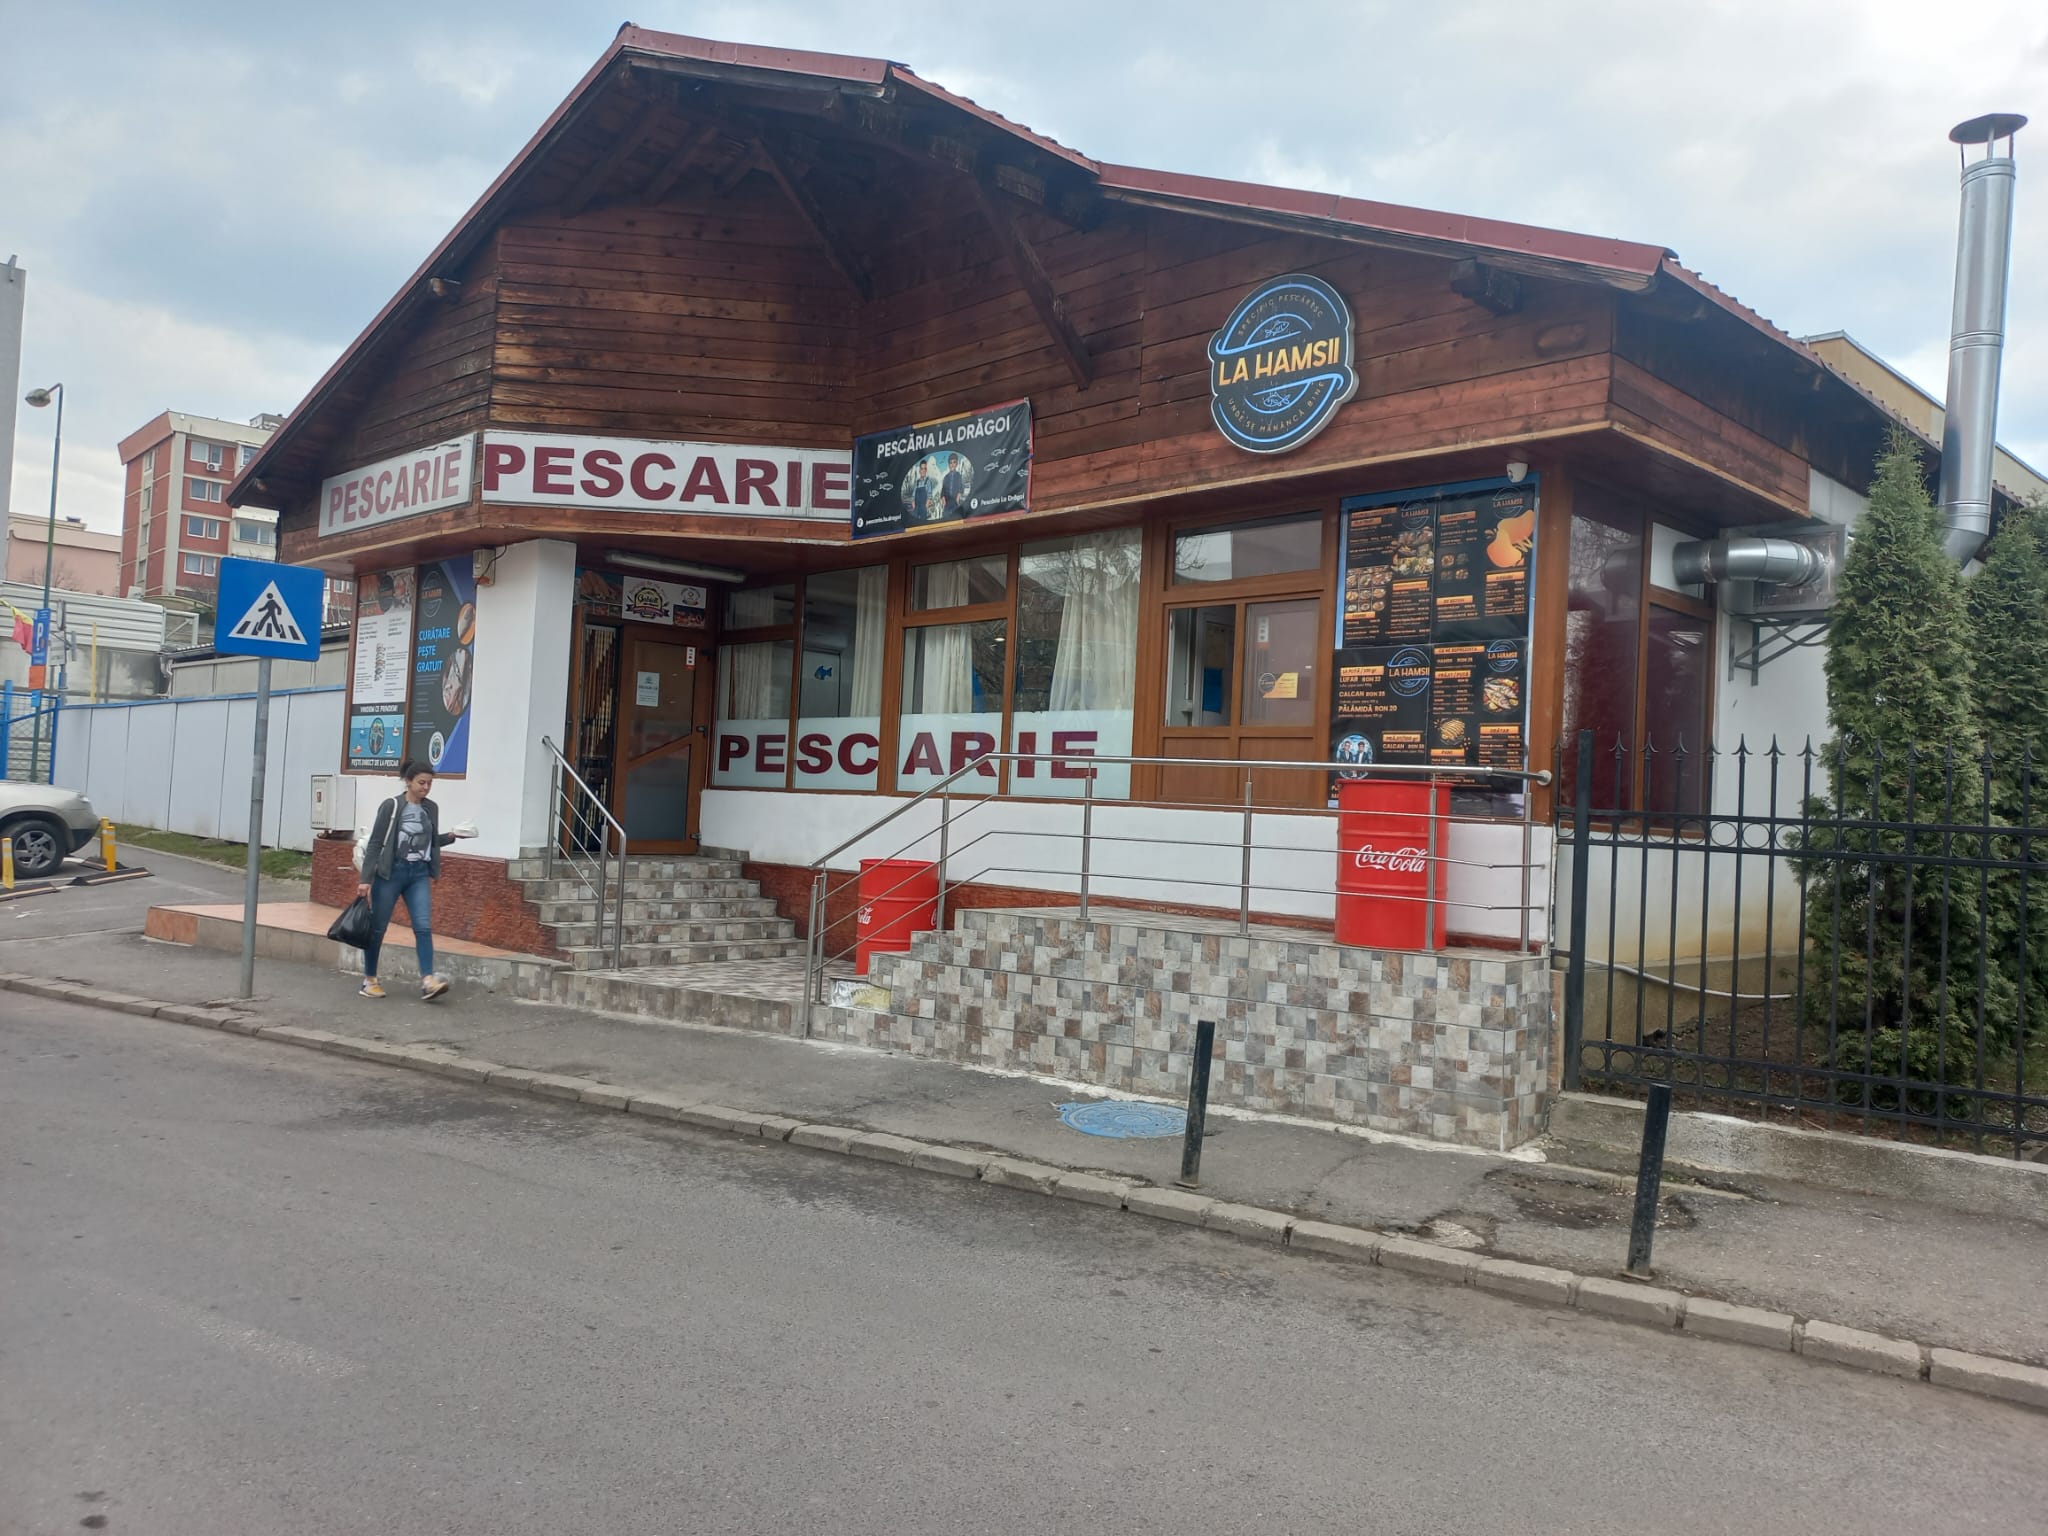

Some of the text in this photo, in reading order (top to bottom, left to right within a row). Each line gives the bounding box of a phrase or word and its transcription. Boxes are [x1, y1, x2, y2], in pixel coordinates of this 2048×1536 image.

[1218, 337, 1341, 386] LA HAMSII
[876, 415, 1011, 458] PESCĂRIA LA DRĂGOI
[328, 450, 462, 528] PESCARIE
[484, 444, 851, 510] PESCARIE
[416, 660, 443, 672] GRATUIT
[1388, 668, 1400, 677] LA
[1401, 667, 1430, 677] HAMSII
